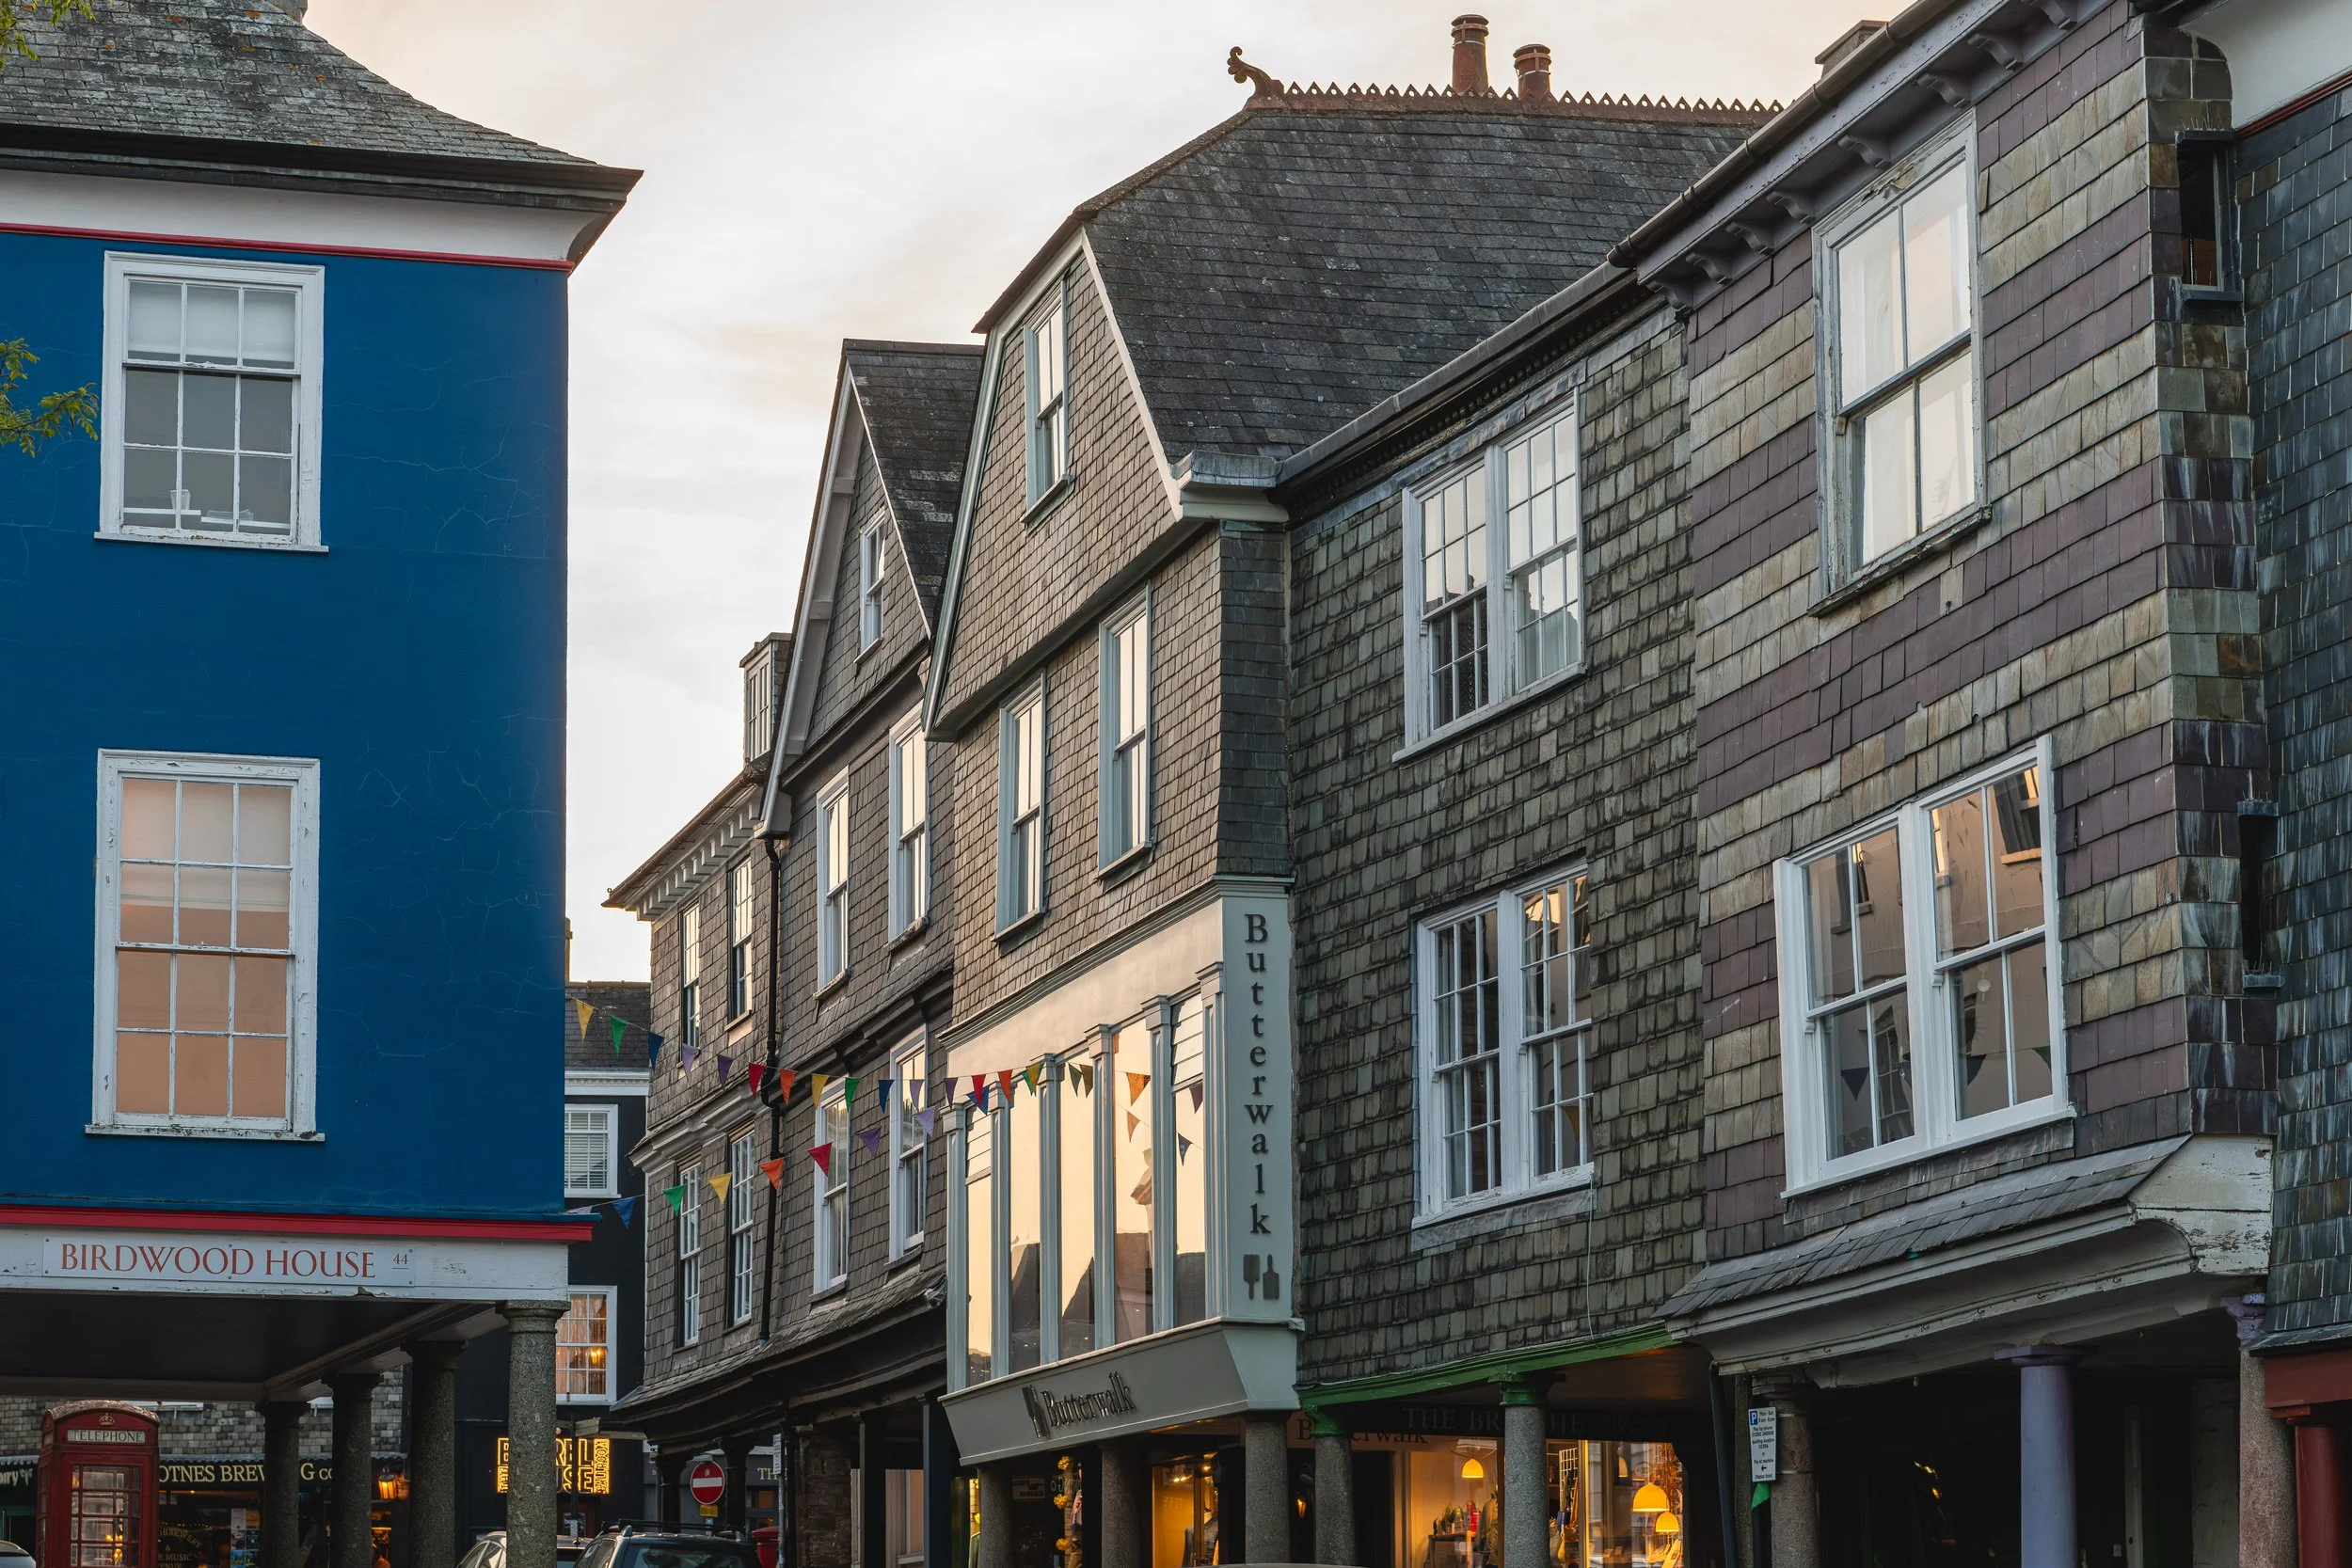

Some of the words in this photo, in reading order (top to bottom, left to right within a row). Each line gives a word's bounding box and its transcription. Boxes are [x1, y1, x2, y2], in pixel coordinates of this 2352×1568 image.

[1245, 913, 1274, 1234] Butterwalk
[61, 1243, 254, 1275] BIRDWOOD
[265, 1249, 376, 1278] HOUSE
[392, 1254, 408, 1265] 44
[1041, 1370, 1136, 1427] Butterwalk
[72, 1430, 143, 1442] TELEPHONE
[158, 1465, 215, 1482] OTNES
[596, 1439, 607, 1492] BALLROOM
[166, 1553, 192, 1561] MUSIC
